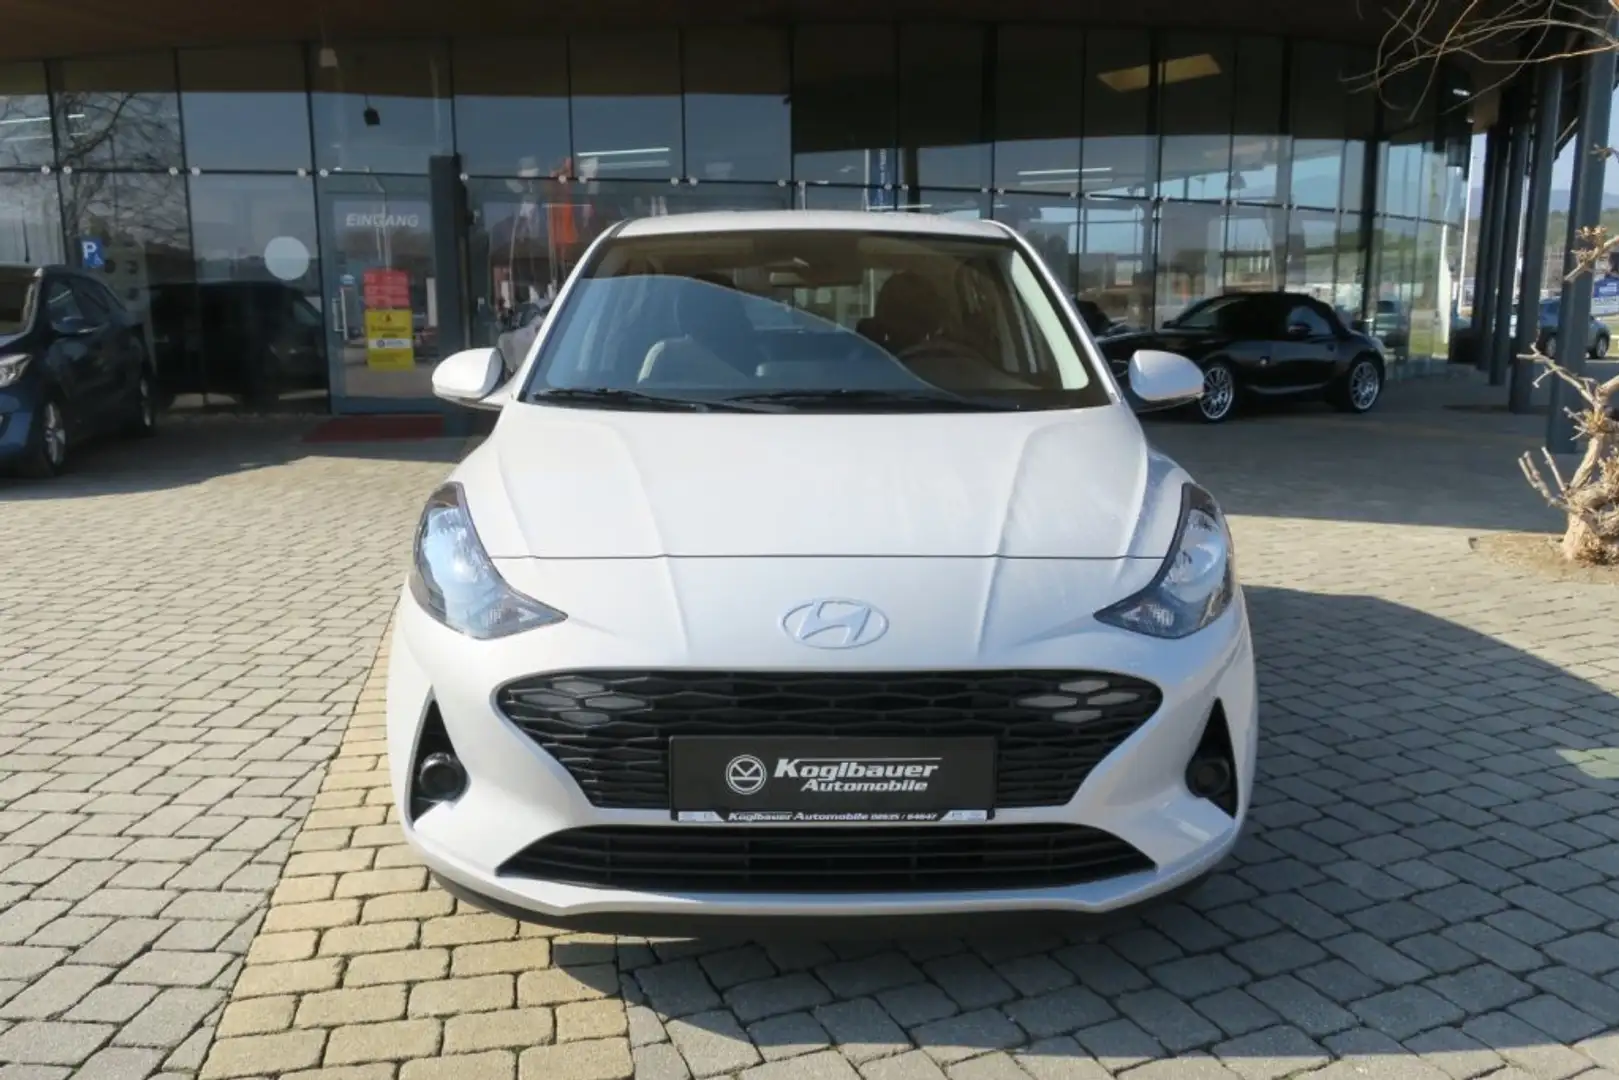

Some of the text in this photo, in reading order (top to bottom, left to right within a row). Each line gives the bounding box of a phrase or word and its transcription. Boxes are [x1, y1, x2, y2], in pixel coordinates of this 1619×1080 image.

[345, 212, 419, 229] EINGANG
[83, 241, 97, 259] P
[773, 757, 940, 781] Koglbauer
[801, 779, 929, 792] Automobile
[728, 811, 793, 822] Koglbauer
[794, 811, 868, 821] Automobile
